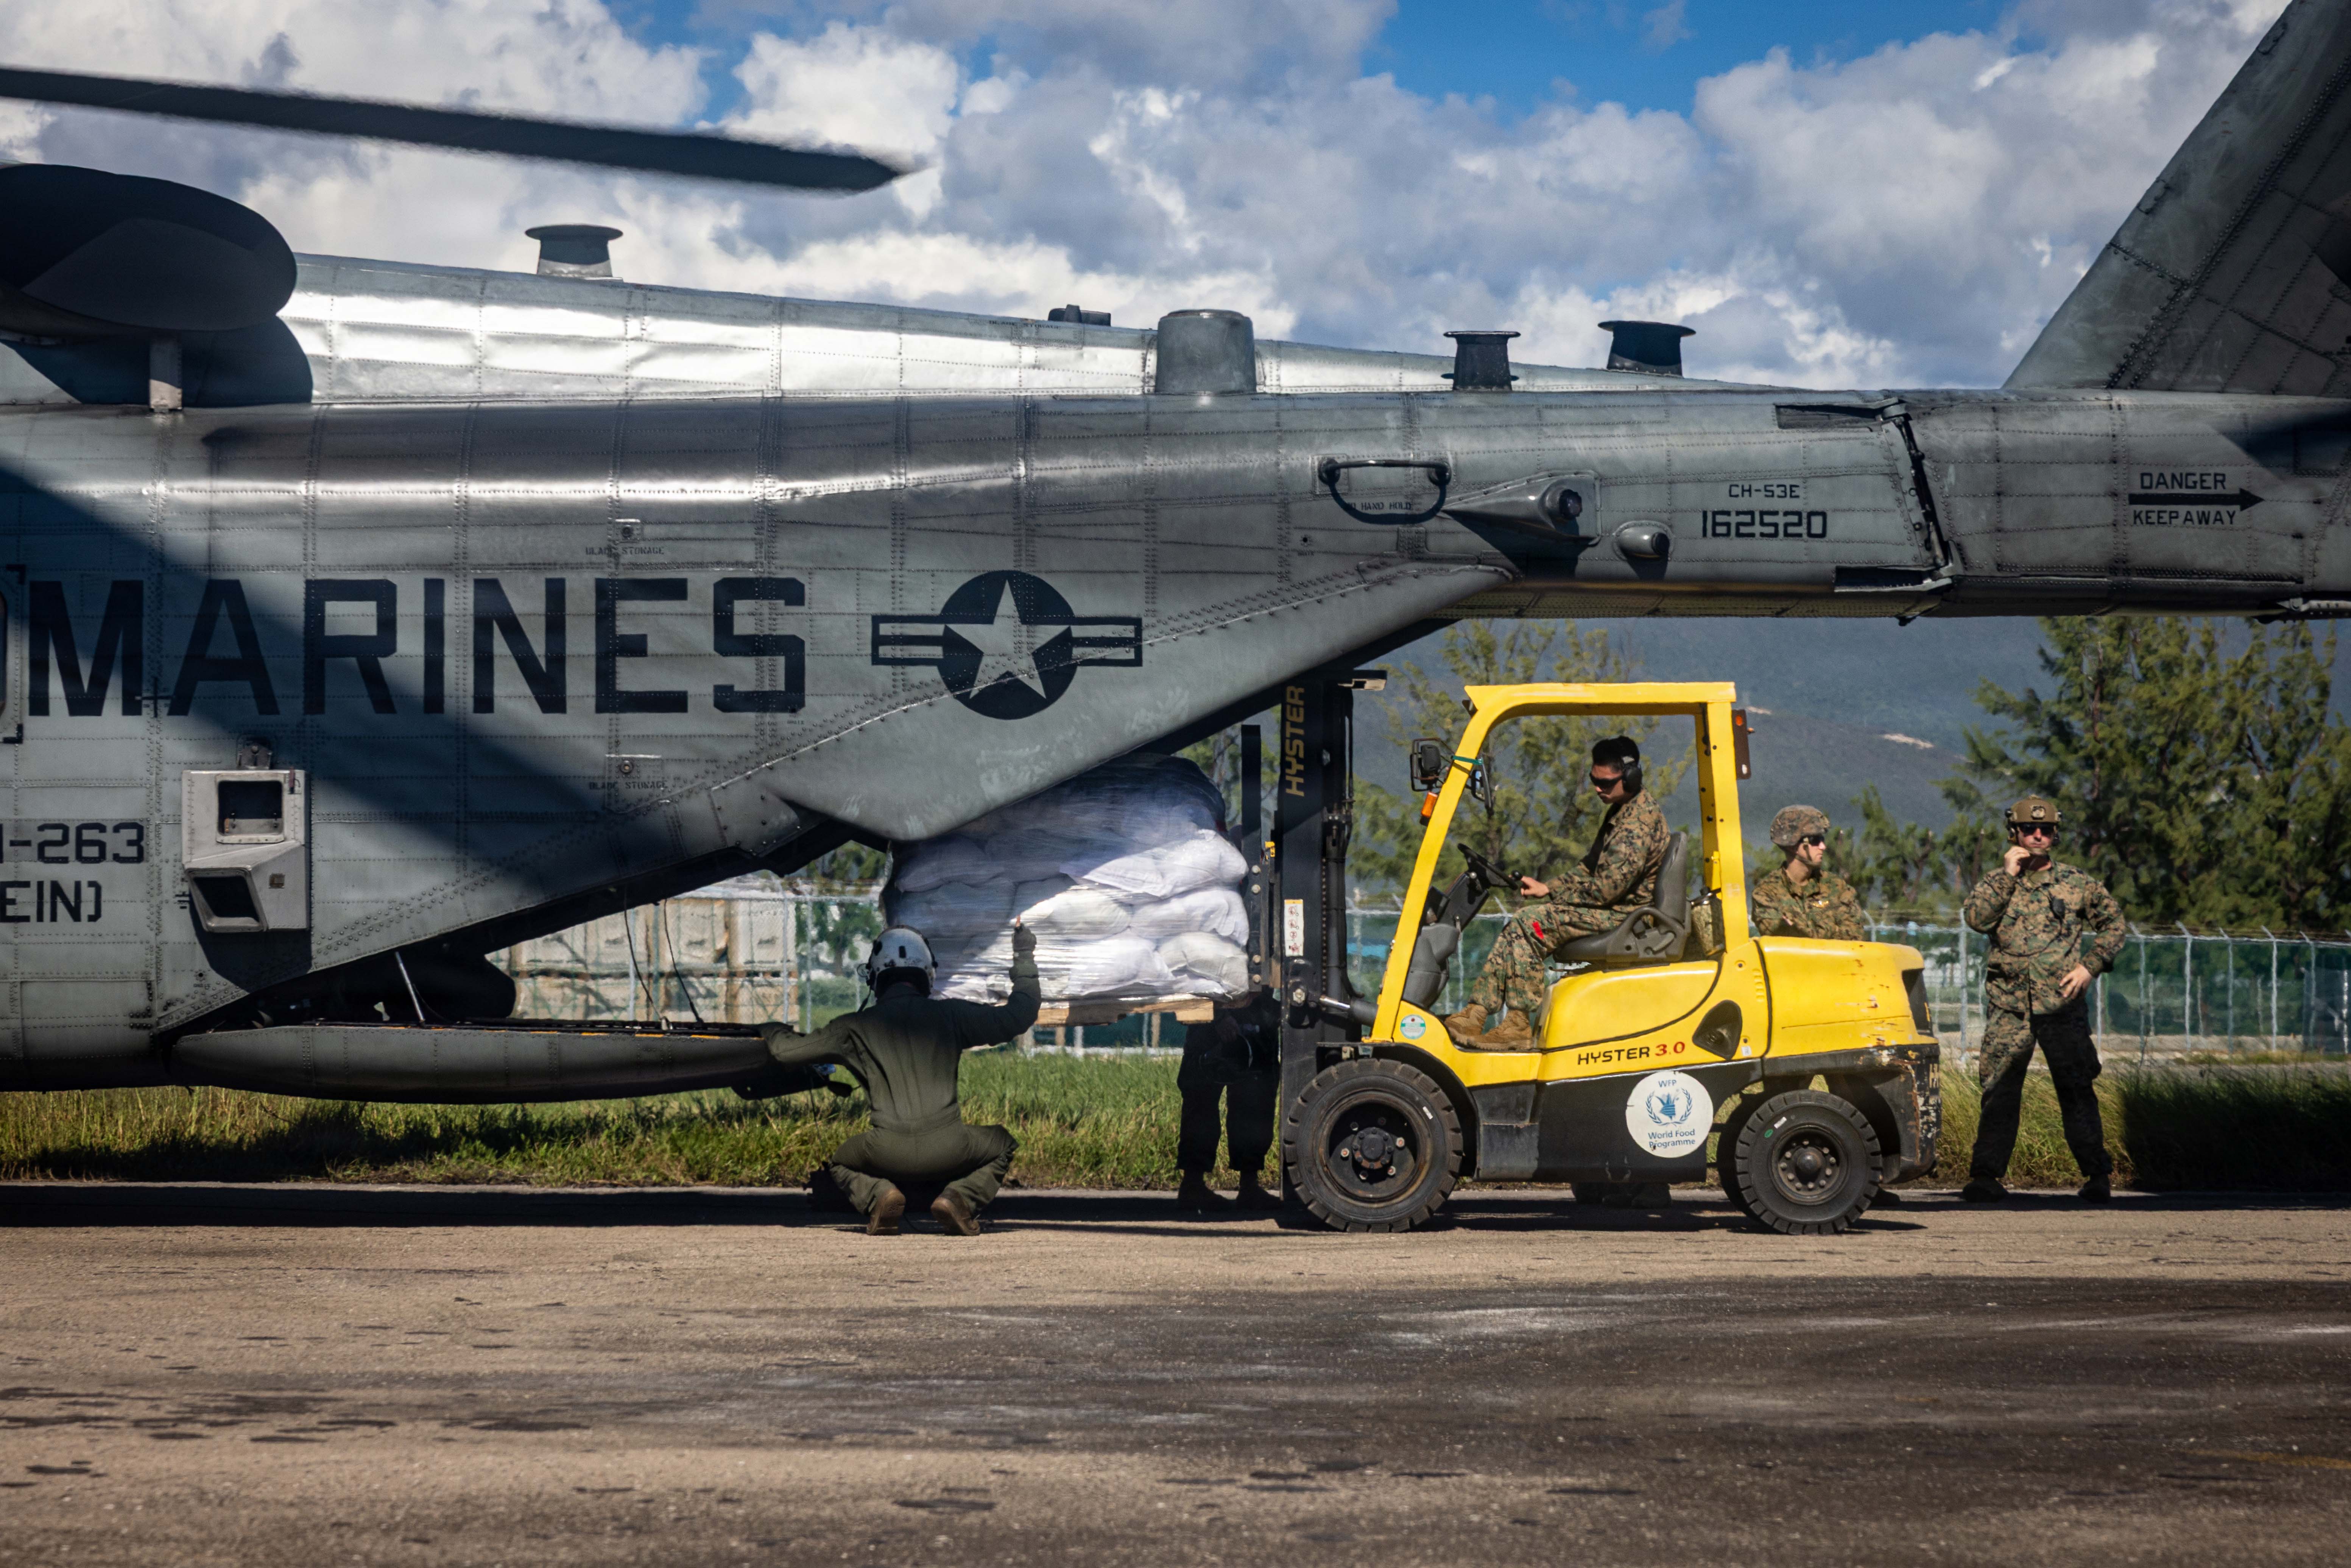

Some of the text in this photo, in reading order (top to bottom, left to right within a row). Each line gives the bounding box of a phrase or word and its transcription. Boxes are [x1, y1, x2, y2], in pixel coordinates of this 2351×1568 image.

[2140, 472, 2226, 489] DANGER
[1729, 484, 1799, 498] CH-53E
[1361, 502, 1384, 510] HAND
[1389, 501, 1412, 510] HOLD
[1702, 511, 1827, 538] 162520
[2133, 510, 2236, 525] KEEP AWAY
[29, 577, 805, 716] MARINES
[1285, 686, 1304, 797] HYSTER
[0, 822, 144, 864] -263
[1578, 1042, 1685, 1065] HYSTER 3.0
[1658, 1079, 1676, 1088] WFP
[1648, 1128, 1695, 1140] World Food
[1649, 1138, 1696, 1149] Programme
